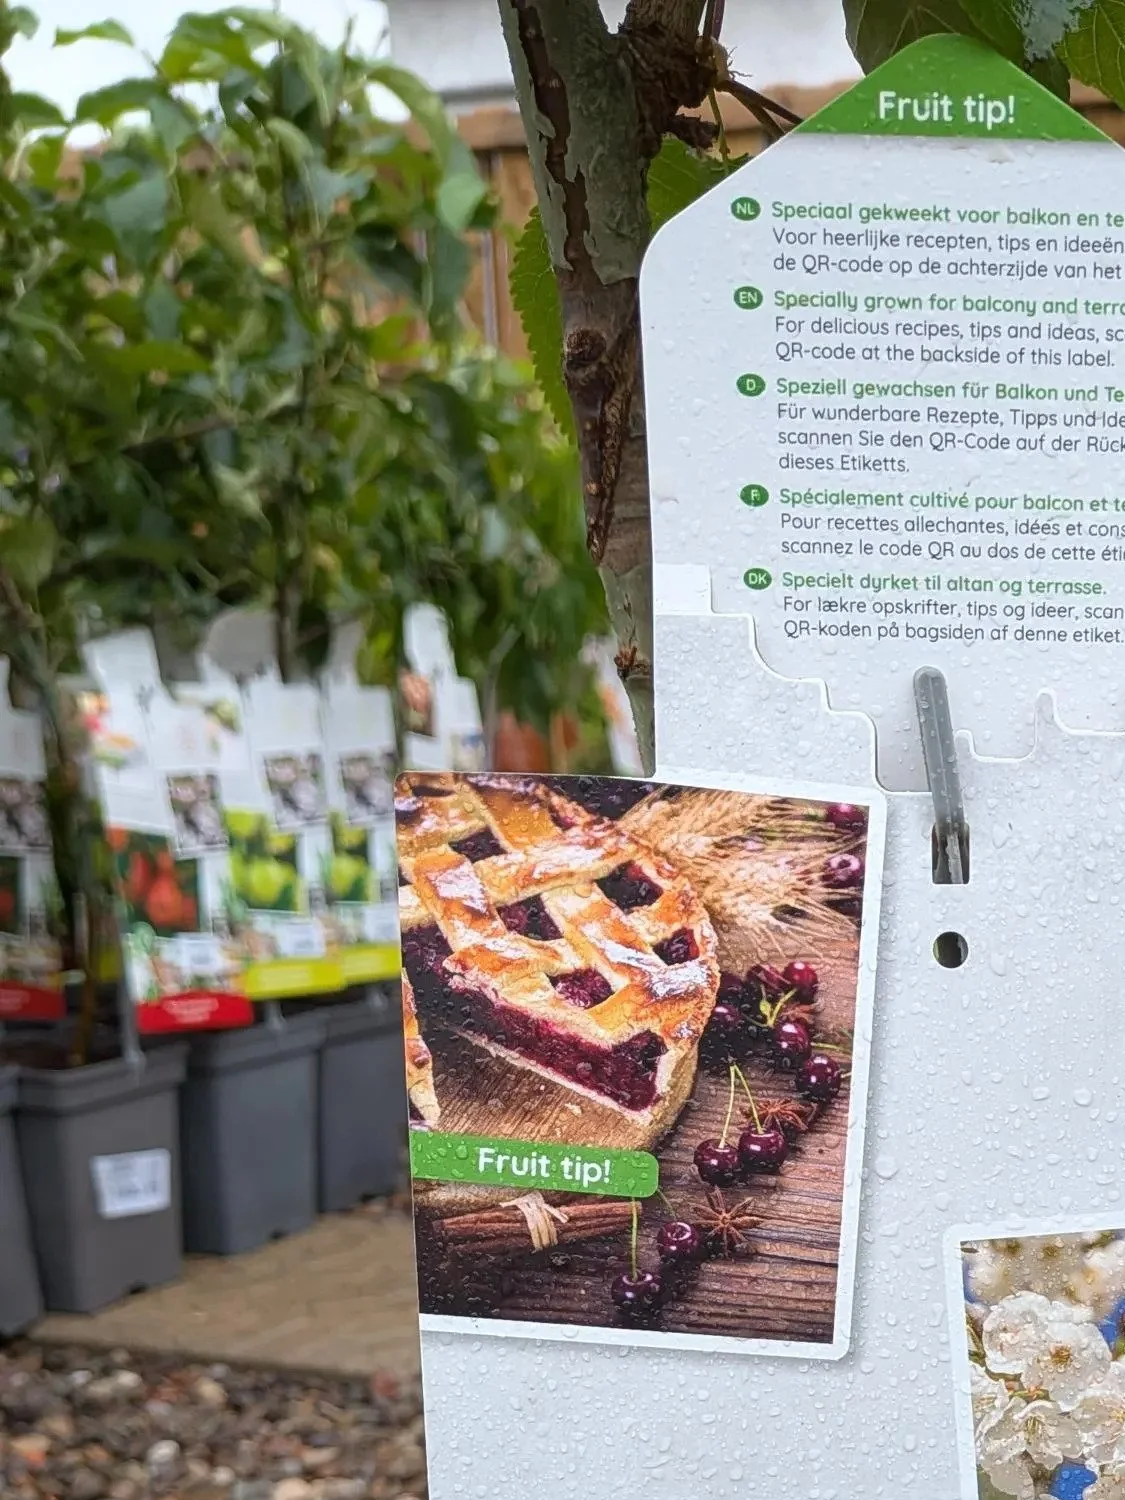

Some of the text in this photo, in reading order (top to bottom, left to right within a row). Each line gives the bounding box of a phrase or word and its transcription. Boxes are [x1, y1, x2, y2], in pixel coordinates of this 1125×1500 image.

[879, 91, 1015, 131] Fruit tip!
[736, 202, 755, 215] NL
[772, 201, 852, 222] Speciaal
[859, 204, 950, 224] gekweekt
[957, 210, 1000, 223] voor
[1007, 207, 1070, 225] balkon
[1077, 214, 1099, 226] en
[773, 228, 817, 245] Voor
[824, 228, 900, 251] heerlijke
[907, 234, 991, 252] recepten,
[998, 234, 1030, 254] tips
[1036, 239, 1057, 251] en
[774, 253, 796, 271] de
[802, 254, 883, 274] QR-code
[889, 260, 912, 277] op
[919, 257, 941, 274] de
[947, 258, 1048, 280] achterzijde
[1054, 265, 1086, 278] van
[1093, 262, 1121, 279] het
[740, 291, 757, 304] EN
[775, 290, 857, 312] Specially
[864, 296, 922, 313] grown
[929, 294, 956, 310] for
[963, 295, 1036, 317] balcony
[1043, 298, 1077, 314] and
[776, 316, 805, 333] For
[811, 316, 889, 335] delicious
[896, 320, 963, 340] recipes,
[969, 322, 1001, 341] tips
[1008, 323, 1041, 339] and
[1048, 323, 1099, 344] ideas,
[776, 342, 1114, 367] QR-code at the backside of this label.
[746, 379, 756, 391] D
[777, 378, 846, 397] Speziell
[853, 380, 955, 399] gewachsen
[962, 382, 989, 398] für
[996, 384, 1058, 400] Balkon
[1065, 386, 1098, 401] und
[778, 403, 806, 419] Für
[812, 404, 920, 422] wunderbare
[927, 407, 1004, 427] Rezepte,
[1010, 409, 1057, 429] Tipps
[1064, 411, 1096, 427] und
[778, 432, 852, 445] scannen
[859, 430, 884, 446] Sie
[890, 430, 923, 448] den
[929, 432, 1010, 451] QR-Code
[1016, 434, 1045, 450] auf
[1051, 435, 1081, 451] der
[779, 453, 909, 472] dieses Etiketts.
[780, 488, 903, 509] Spécialement
[910, 492, 968, 508] cultivé
[975, 497, 1018, 512] pour
[1024, 494, 1083, 511] balcon
[1090, 498, 1108, 511] et
[781, 513, 822, 529] Pour
[828, 516, 898, 531] recettes
[905, 516, 1009, 536] allechantes,
[1015, 519, 1060, 536] idées
[1066, 522, 1082, 536] et
[782, 541, 853, 554] scannez
[860, 539, 873, 555] le
[879, 540, 922, 556] code
[928, 541, 954, 560] QR
[960, 546, 981, 558] au
[988, 542, 1019, 559] dos
[1024, 543, 1045, 559] de
[1052, 546, 1095, 560] cette
[749, 572, 767, 584] DK
[783, 572, 1106, 596] Specielt dyrket til altan og terrasse.
[784, 596, 1123, 621] For lækre opskrifter, tips og ideer, scan
[784, 620, 1124, 643] QR-koden på bagsiden af denne etiket.
[478, 1147, 611, 1188] Fruit tip!
